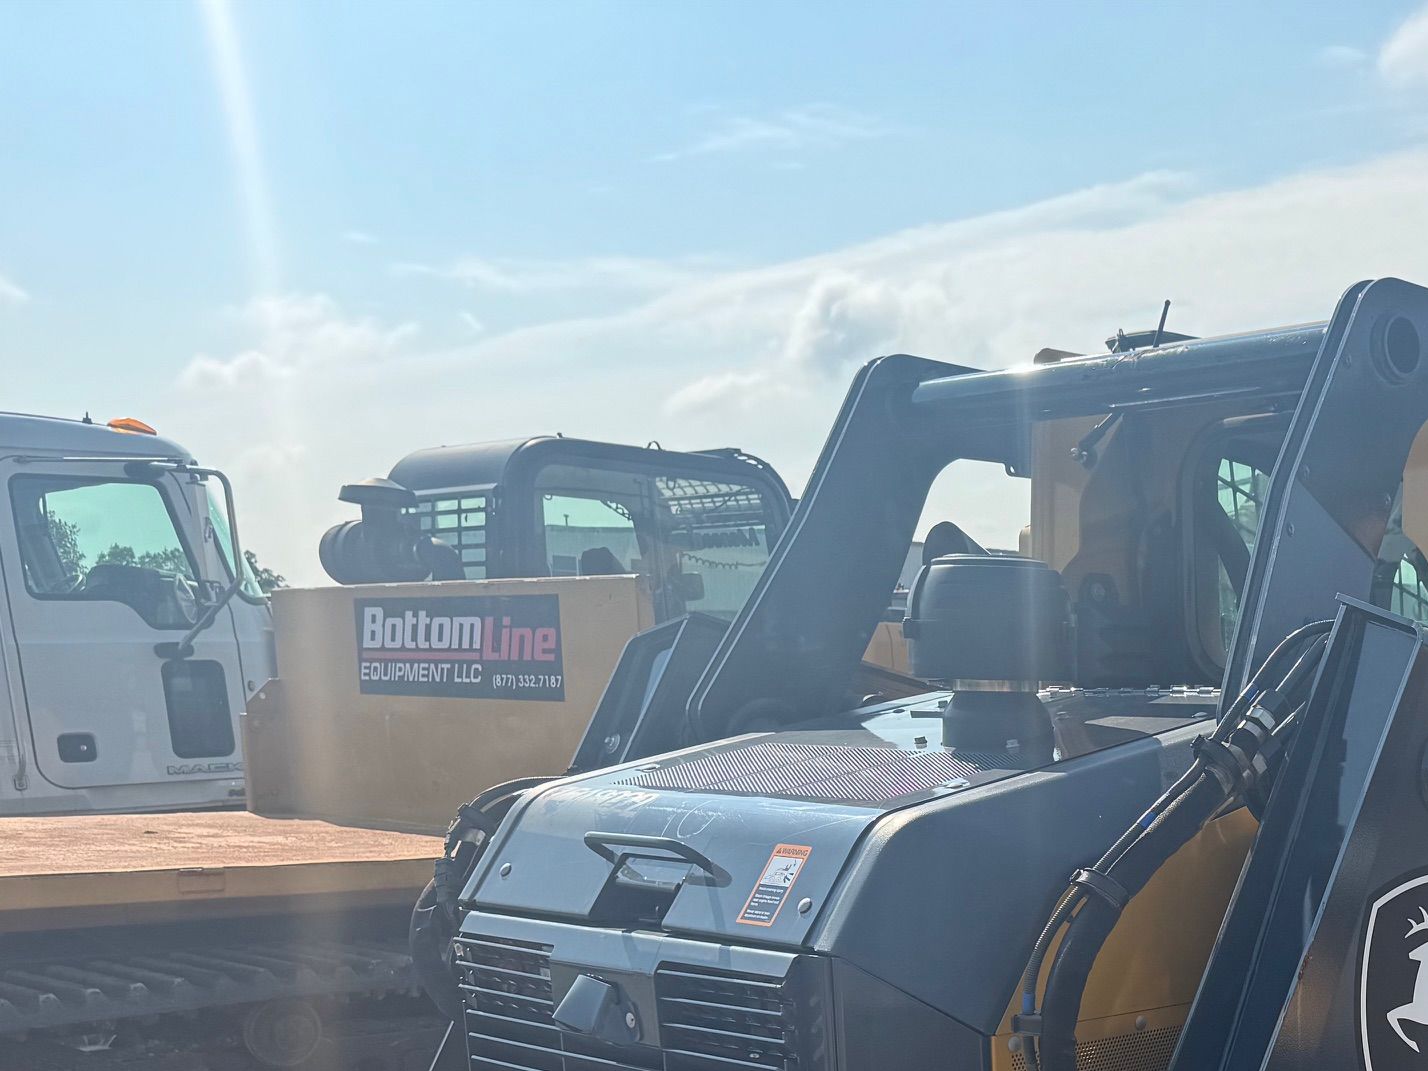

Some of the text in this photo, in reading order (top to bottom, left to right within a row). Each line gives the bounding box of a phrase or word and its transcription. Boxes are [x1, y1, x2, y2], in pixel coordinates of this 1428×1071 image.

[361, 662, 562, 690] EQUIPMENT LLC (877) 332.7187
